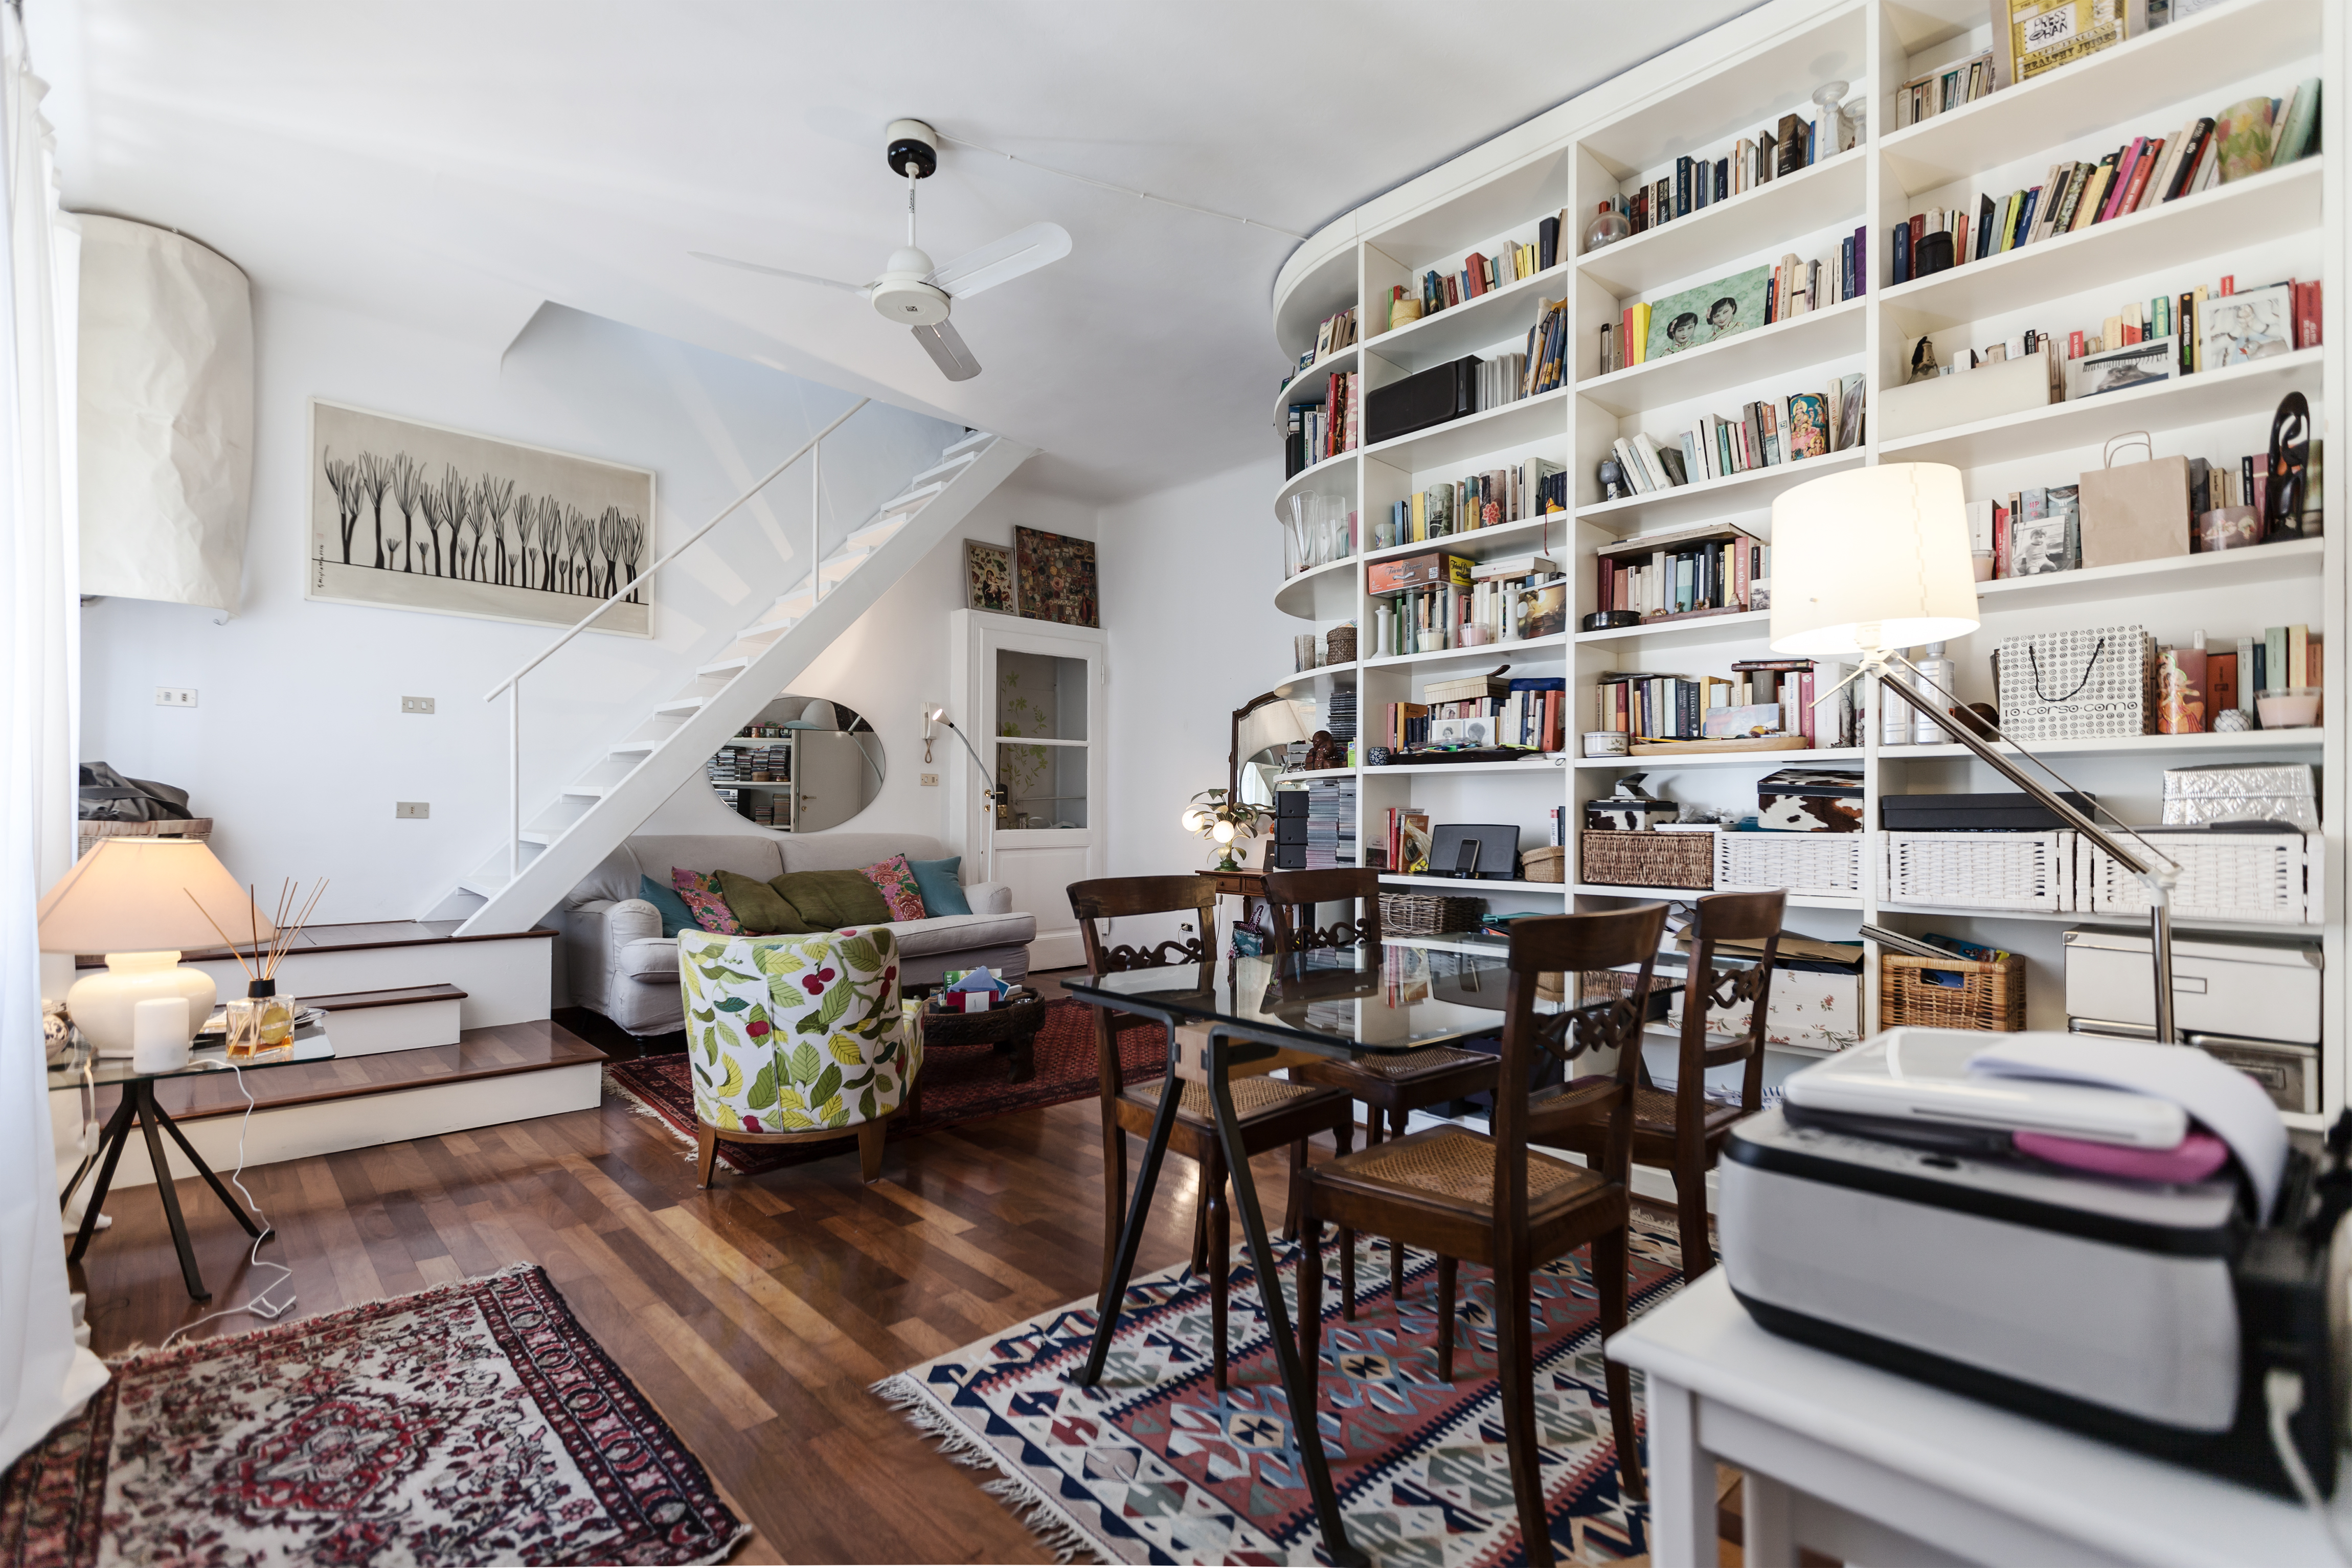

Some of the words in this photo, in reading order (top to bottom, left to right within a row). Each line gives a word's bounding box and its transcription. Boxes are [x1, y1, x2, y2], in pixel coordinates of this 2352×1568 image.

[2023, 47, 2074, 73] HEALTHY
[2078, 30, 2117, 54] JUICES
[1829, 399, 1837, 414] Signori
[1385, 566, 1403, 576] Trivial
[1401, 562, 1423, 572] Pursuit
